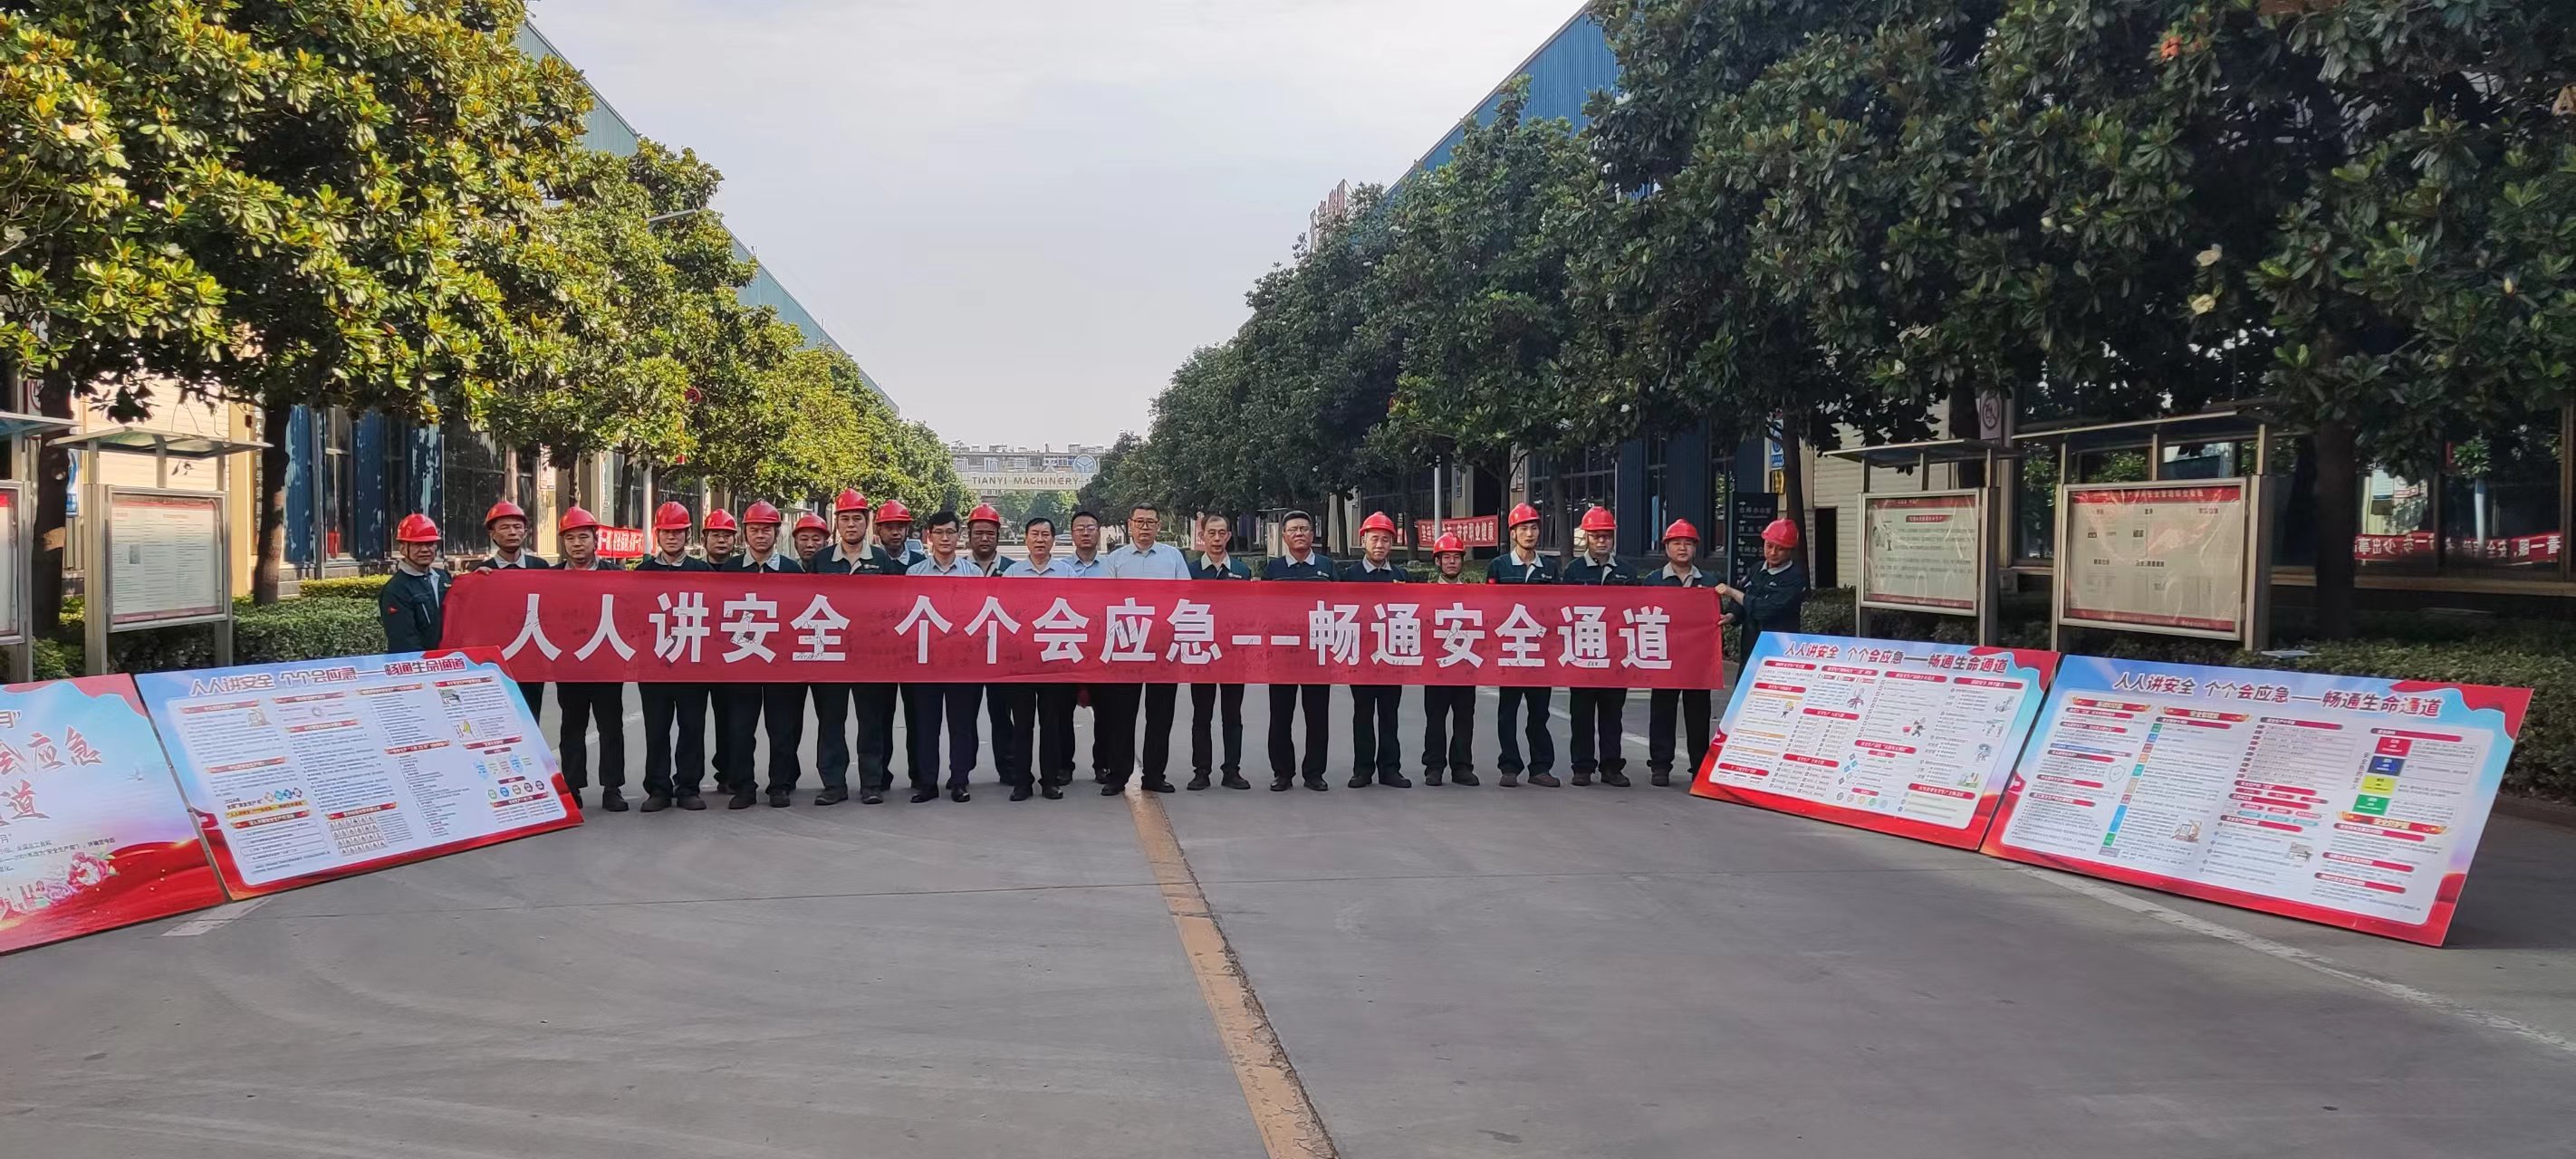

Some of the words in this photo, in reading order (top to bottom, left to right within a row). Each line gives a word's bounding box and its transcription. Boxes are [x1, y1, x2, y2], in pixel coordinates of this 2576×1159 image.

[972, 476, 1007, 485] TIANYI
[1014, 476, 1080, 485] MACHINERY
[503, 593, 851, 664] 人人讲安全
[1785, 643, 1839, 659] 人人讲安全
[191, 674, 274, 695] 人人讲安全
[2114, 672, 2197, 697] 人人讲安全
[0, 779, 50, 827] 道
